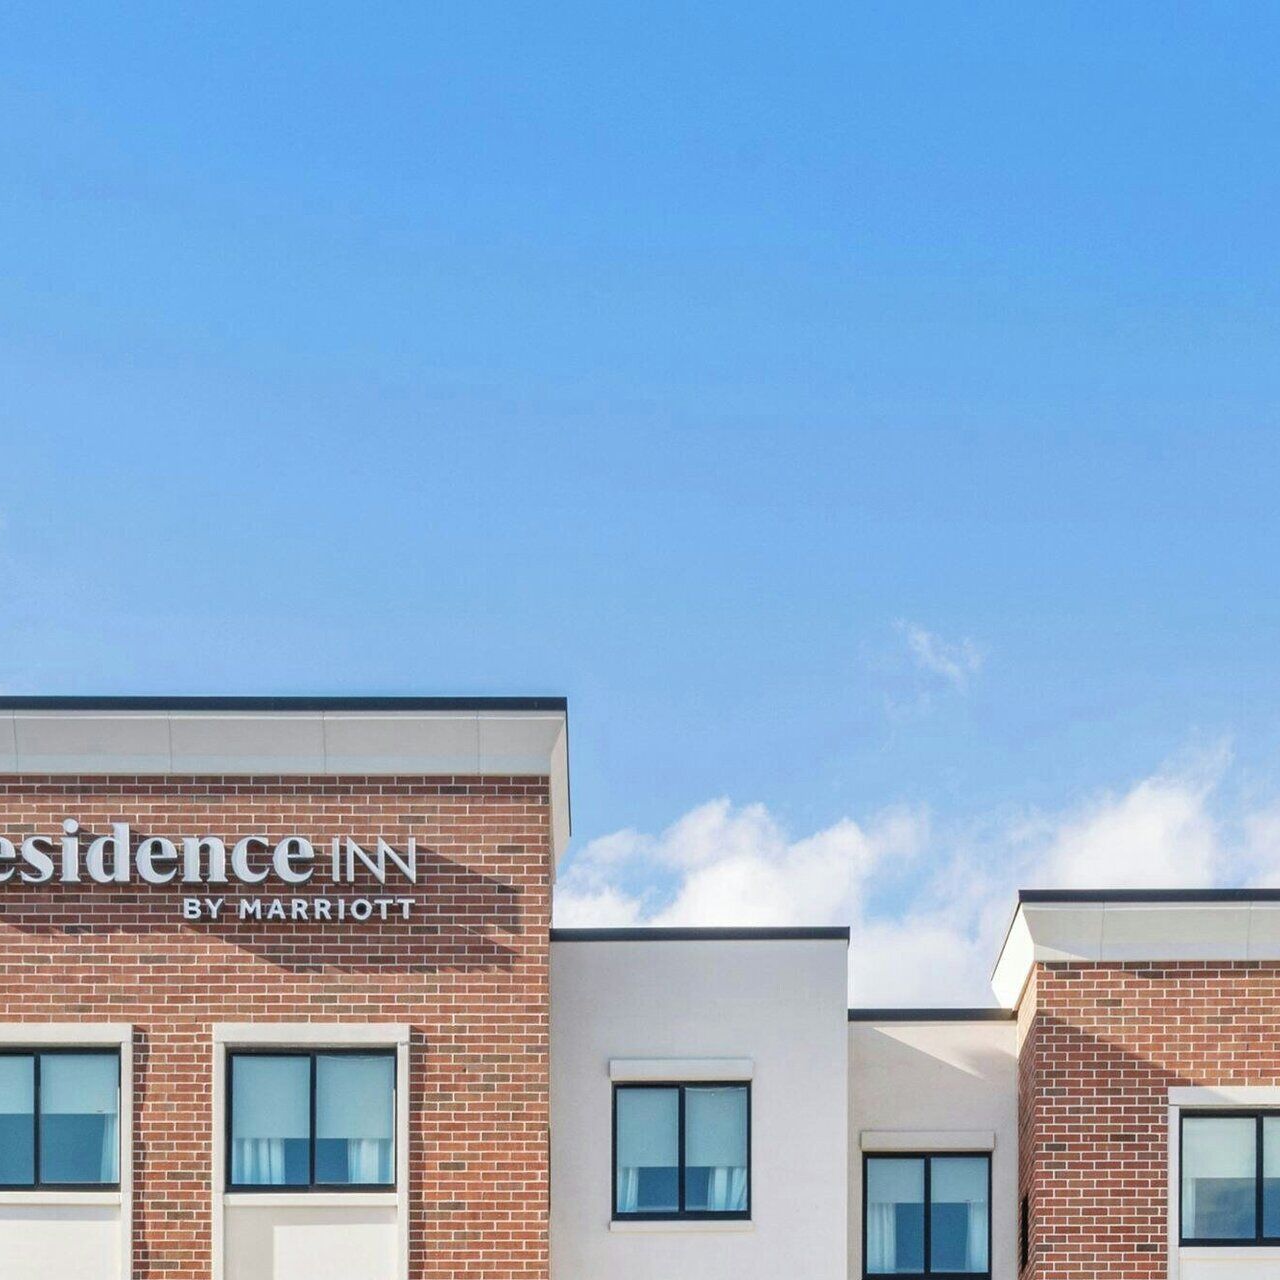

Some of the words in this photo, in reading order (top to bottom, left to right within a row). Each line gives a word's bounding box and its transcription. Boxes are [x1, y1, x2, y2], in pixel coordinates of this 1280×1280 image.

[331, 836, 417, 884] INN
[182, 898, 223, 920] BY
[239, 898, 417, 921] MARRIOTT
